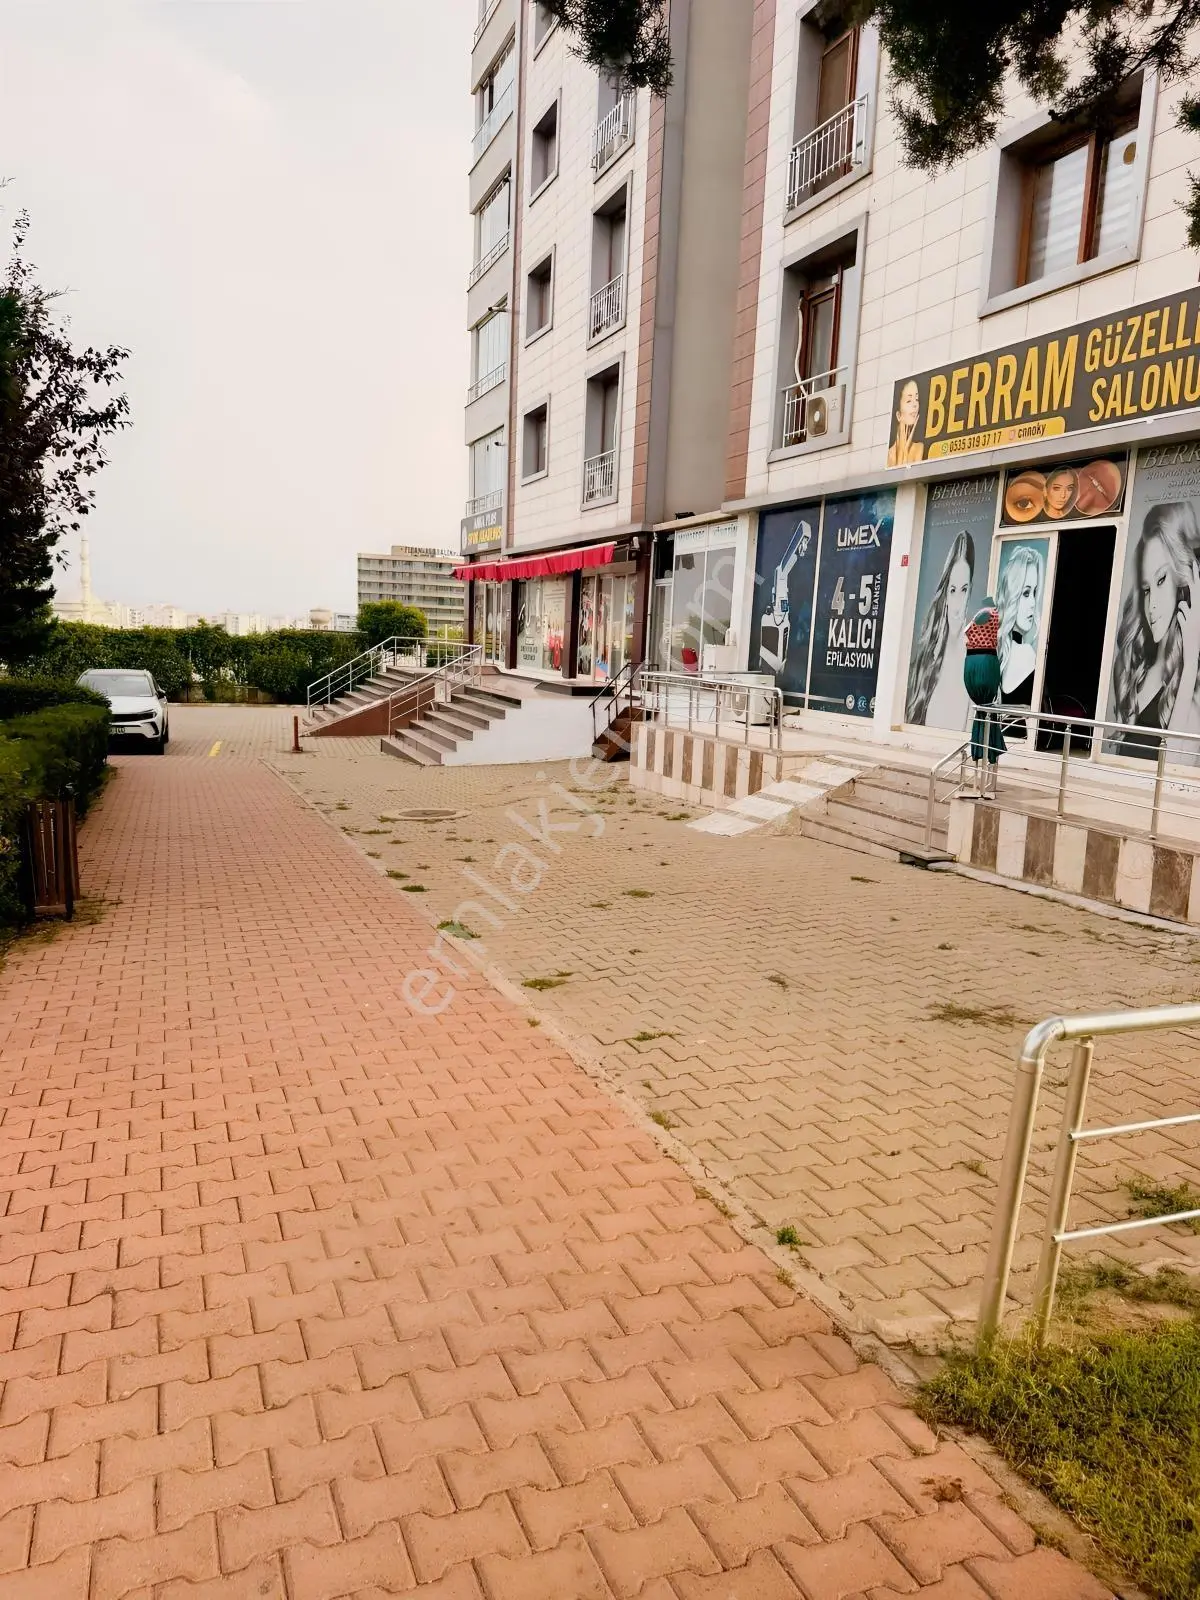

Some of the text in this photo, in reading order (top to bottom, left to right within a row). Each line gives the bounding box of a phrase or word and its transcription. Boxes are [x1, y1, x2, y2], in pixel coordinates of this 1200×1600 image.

[925, 335, 1080, 439] BERRAM
[1088, 355, 1200, 422] SALONU
[949, 438, 966, 453] 0535
[967, 435, 981, 449] 319
[982, 433, 991, 447] 37
[993, 431, 1002, 444] 17
[931, 476, 996, 501] BERRAM
[837, 519, 884, 548] UMEX
[872, 573, 882, 617] SEANSTA
[827, 618, 877, 649] KALICI
